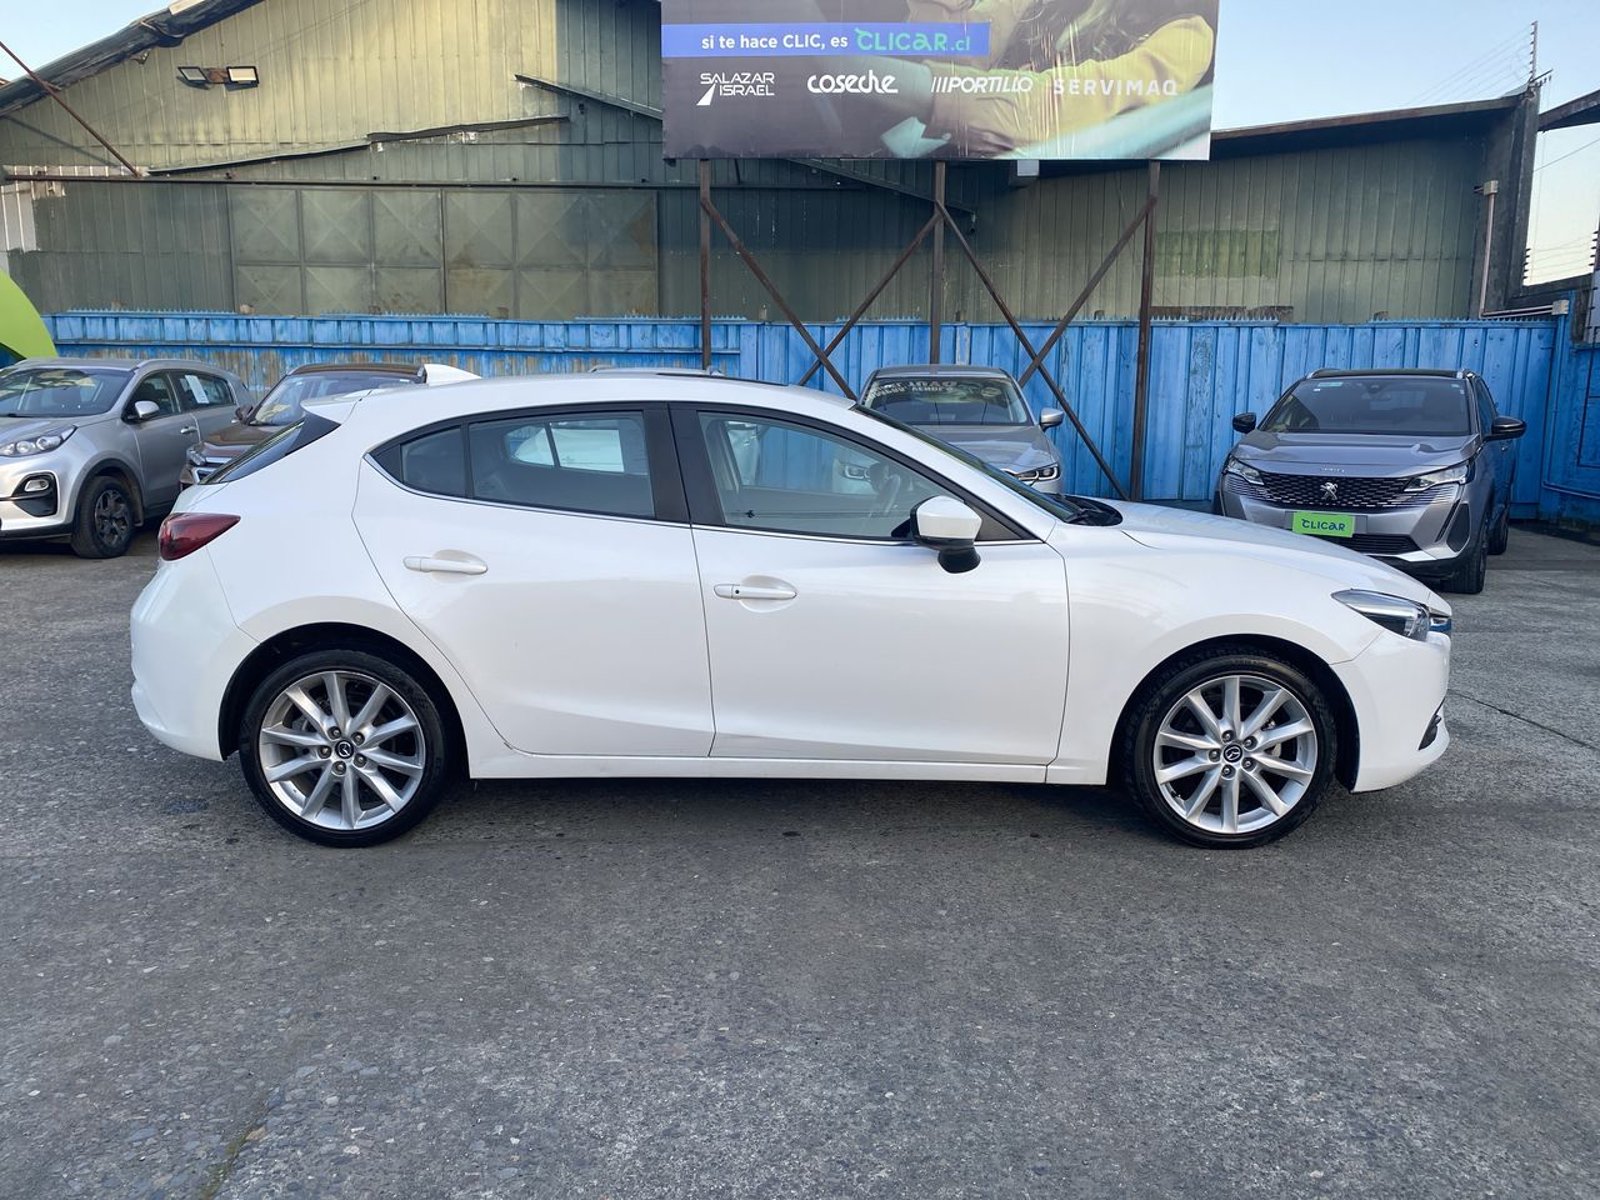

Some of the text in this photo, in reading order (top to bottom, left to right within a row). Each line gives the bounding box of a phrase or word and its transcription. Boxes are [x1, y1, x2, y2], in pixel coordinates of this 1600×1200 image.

[701, 35, 715, 49] si
[719, 36, 735, 49] te
[740, 35, 777, 48] hace
[783, 34, 826, 50] CLIC,
[830, 37, 848, 48] es
[700, 72, 775, 85] SALAZAR
[719, 84, 775, 96] ISRAEL
[1054, 79, 1177, 95] SERVIMAQ
